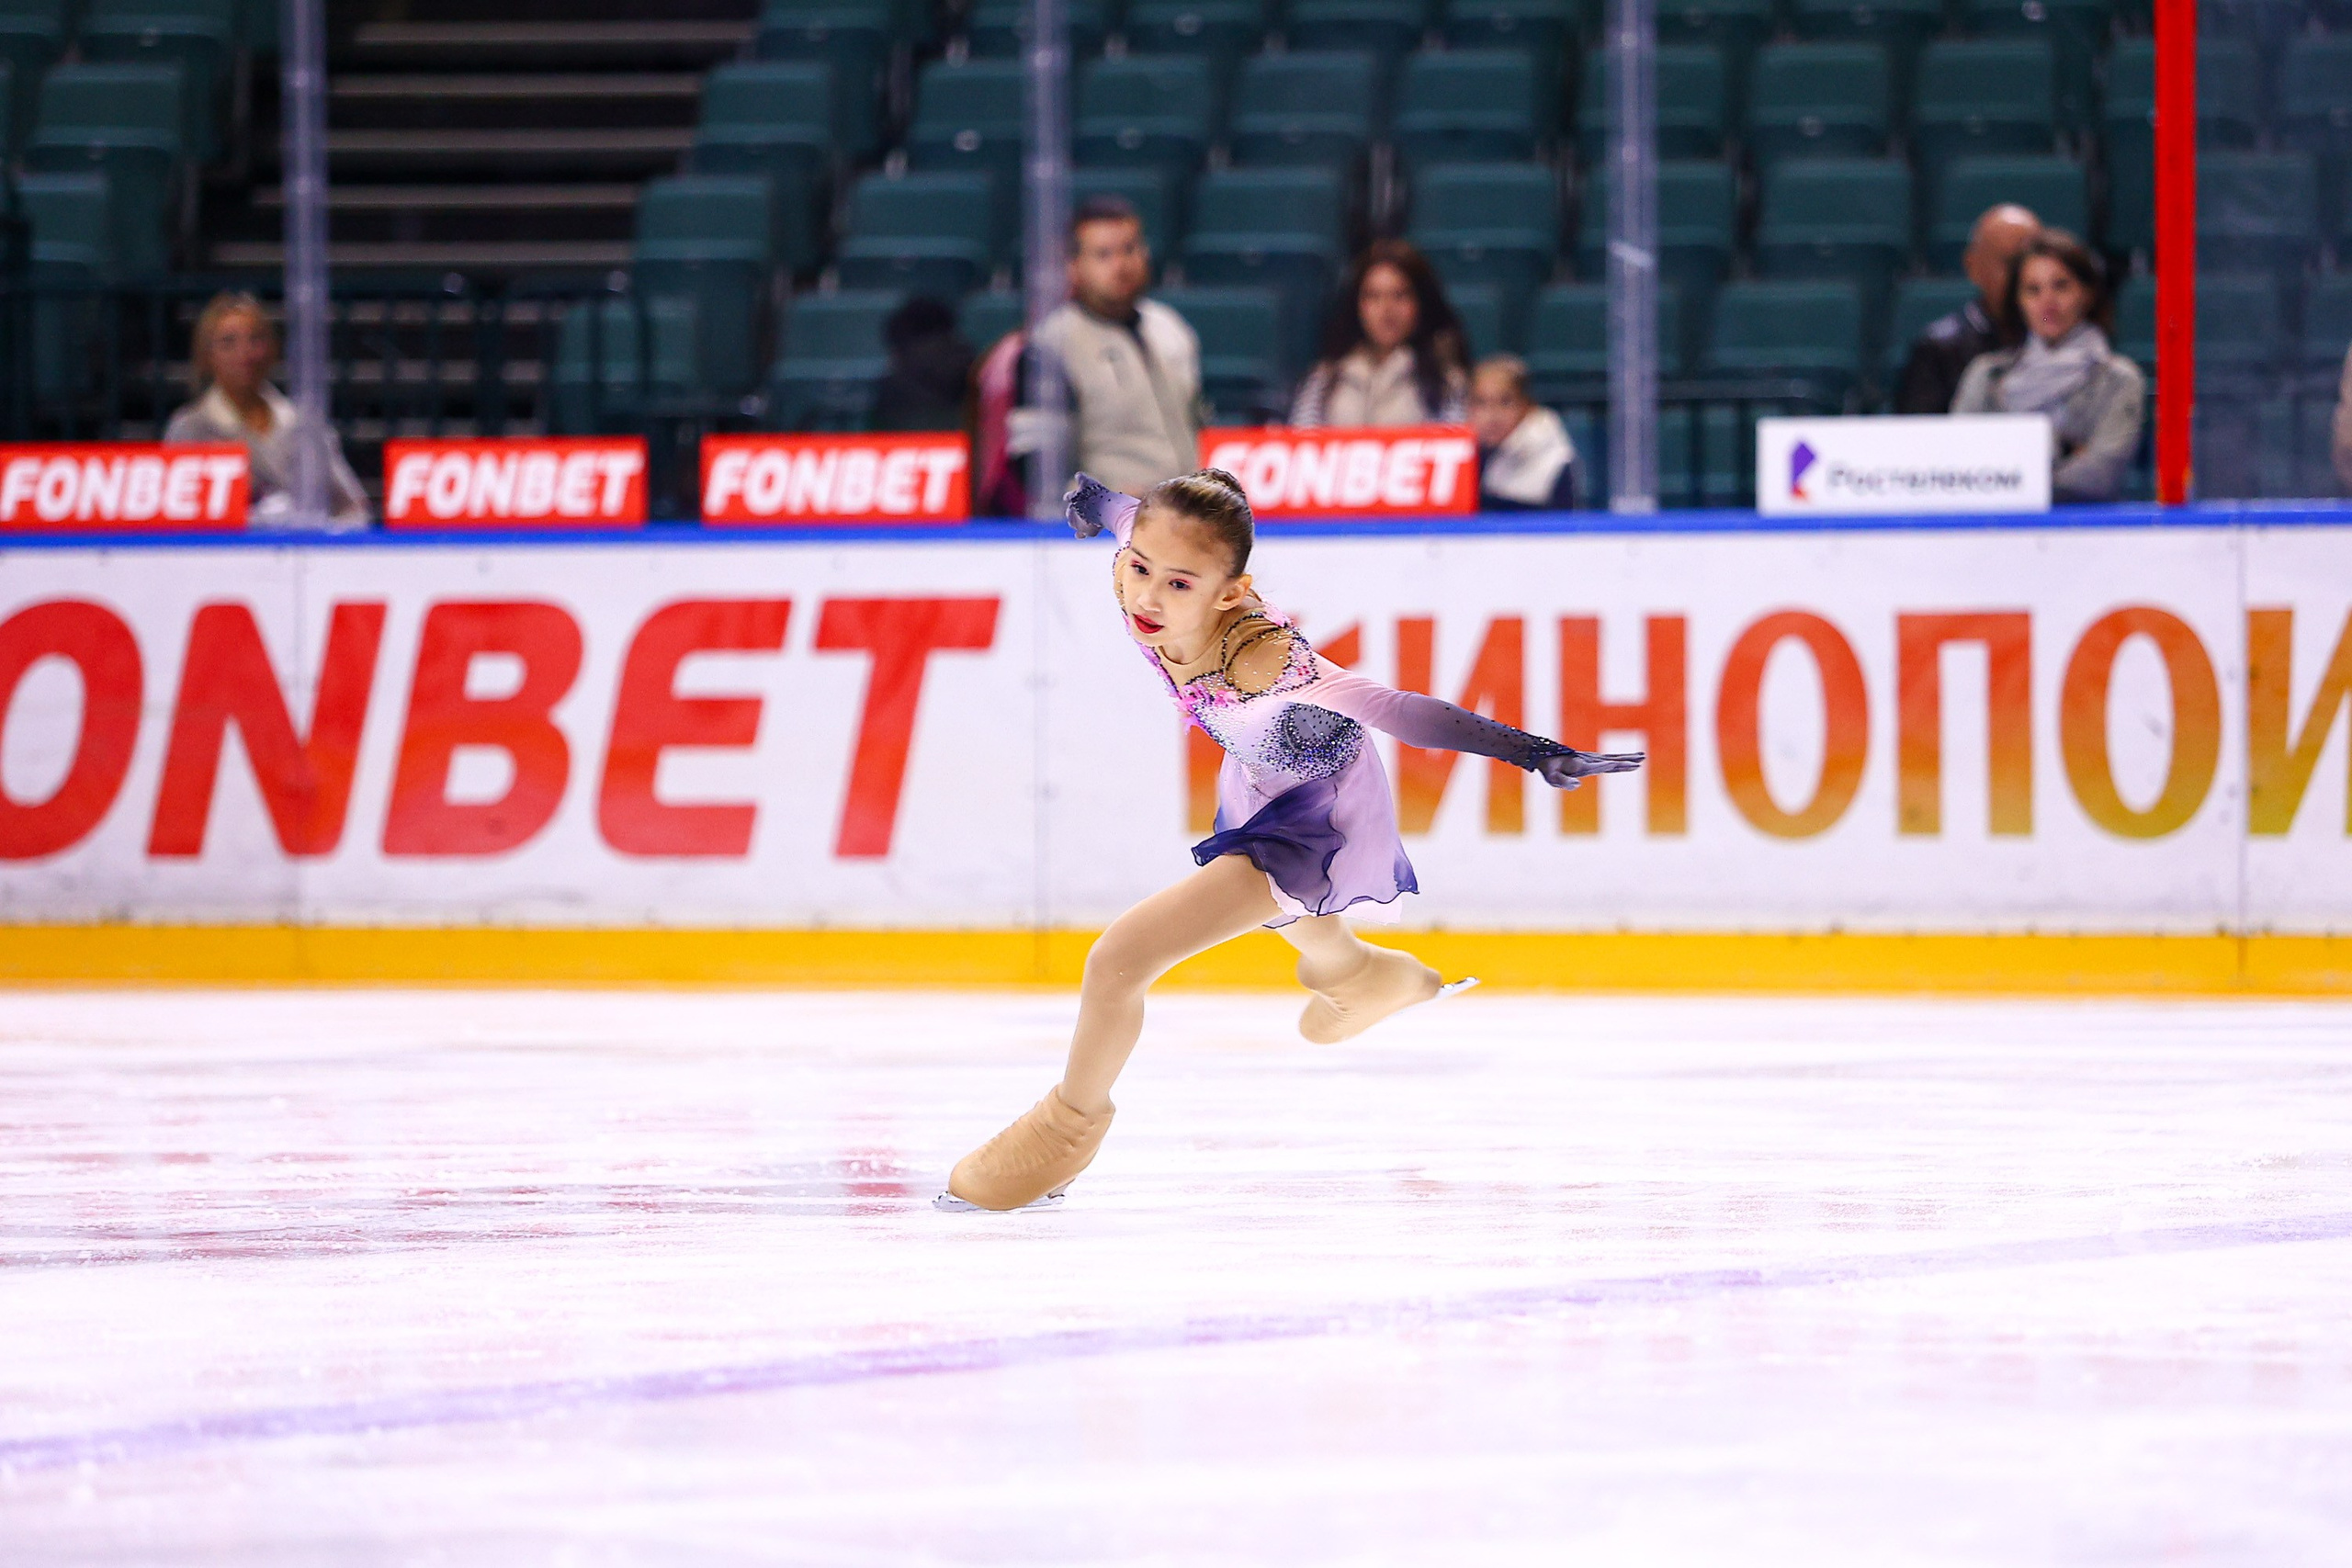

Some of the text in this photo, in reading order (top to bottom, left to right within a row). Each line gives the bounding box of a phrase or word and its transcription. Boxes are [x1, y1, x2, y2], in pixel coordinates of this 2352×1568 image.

[0, 456, 243, 520] FONBET
[387, 451, 642, 517] FONBET
[703, 447, 965, 514] FONBET
[0, 596, 1001, 862] ONBET
